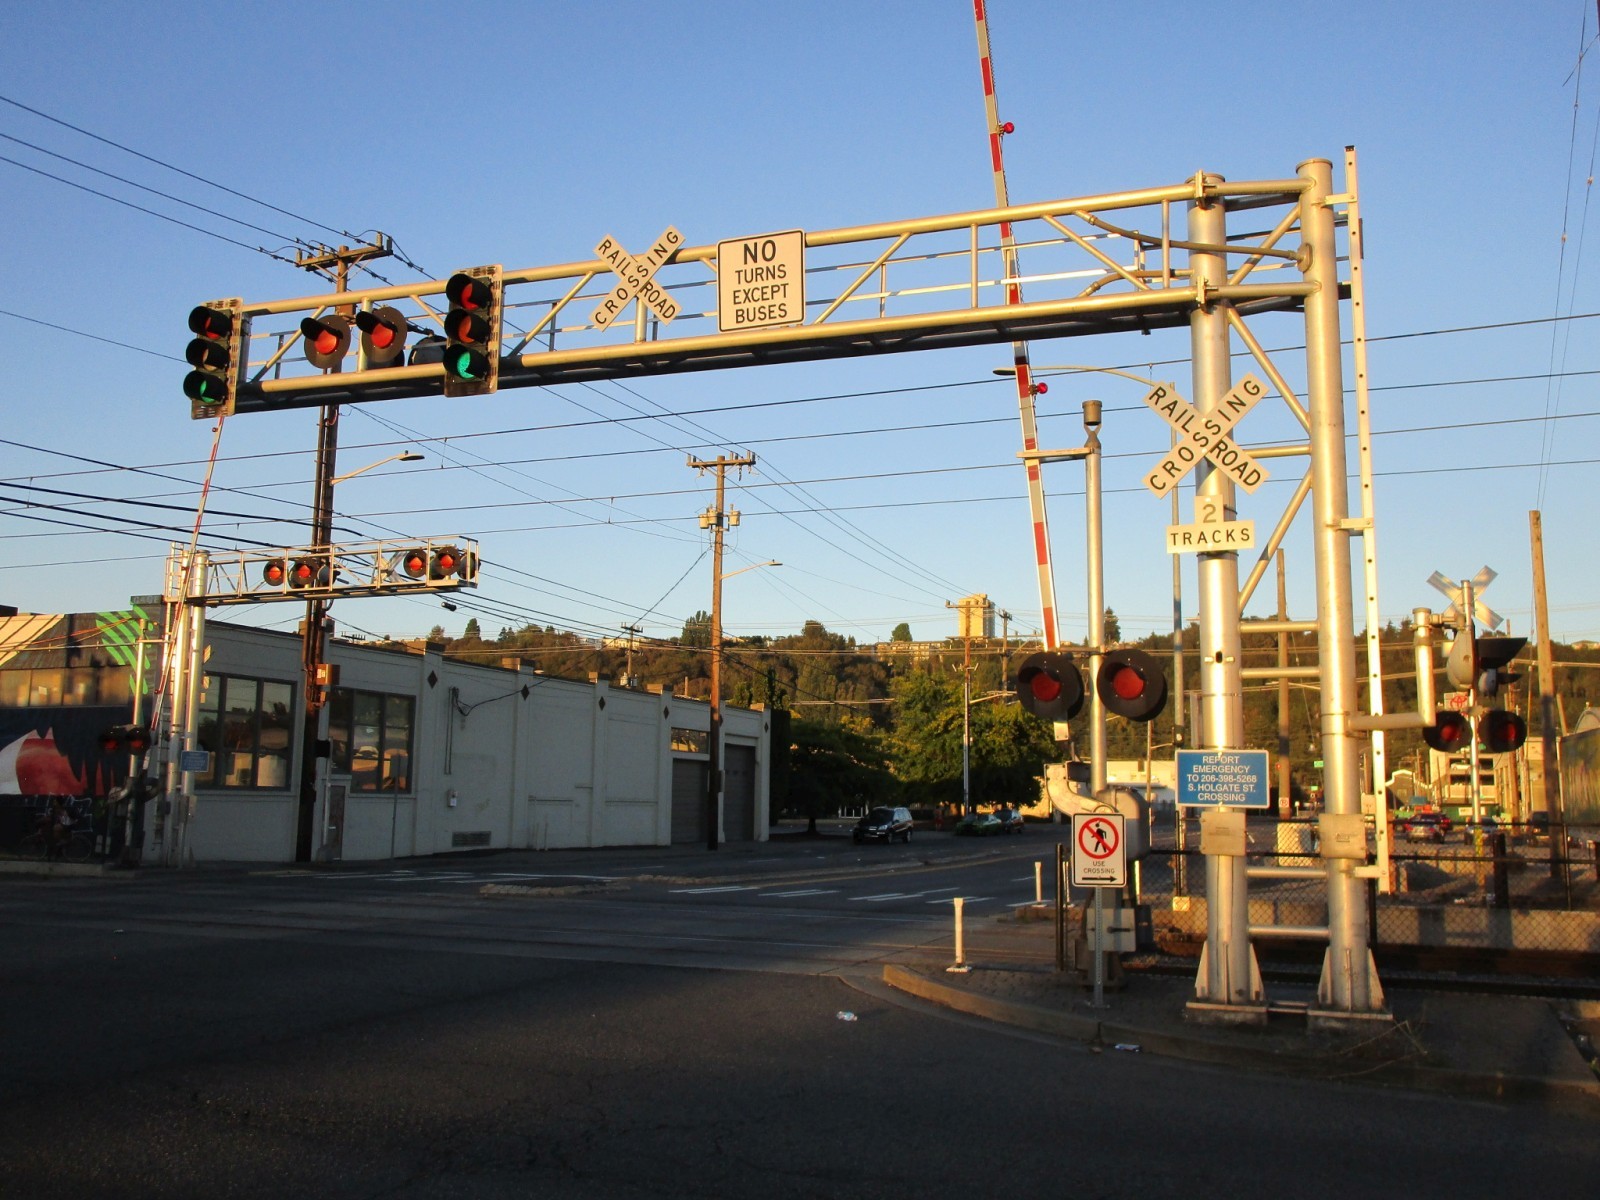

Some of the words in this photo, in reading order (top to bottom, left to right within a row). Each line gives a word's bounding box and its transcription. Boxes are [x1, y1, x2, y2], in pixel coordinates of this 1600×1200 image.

[743, 239, 776, 265] NO
[594, 230, 679, 325] CROSSING
[598, 239, 631, 276] RAIL
[639, 281, 676, 320] ROAD
[735, 263, 787, 285] TURNS
[733, 283, 789, 305] EXCEPT
[735, 303, 788, 324] BUSES
[1148, 386, 1195, 433] RAIL
[1210, 438, 1261, 487] ROAD
[1150, 380, 1261, 490] CROSSING
[1202, 503, 1217, 524] 2
[1170, 527, 1250, 546] TRACKS
[1193, 765, 1250, 773] EMERGENCY
[1202, 755, 1240, 764] REPORT
[1187, 774, 1199, 782] TO
[1201, 774, 1257, 783] 206-398-5268
[1187, 783, 1196, 791] S.
[1198, 783, 1240, 792] HOLGATE
[1243, 784, 1256, 793] ST.
[1197, 793, 1246, 801] CROSSING
